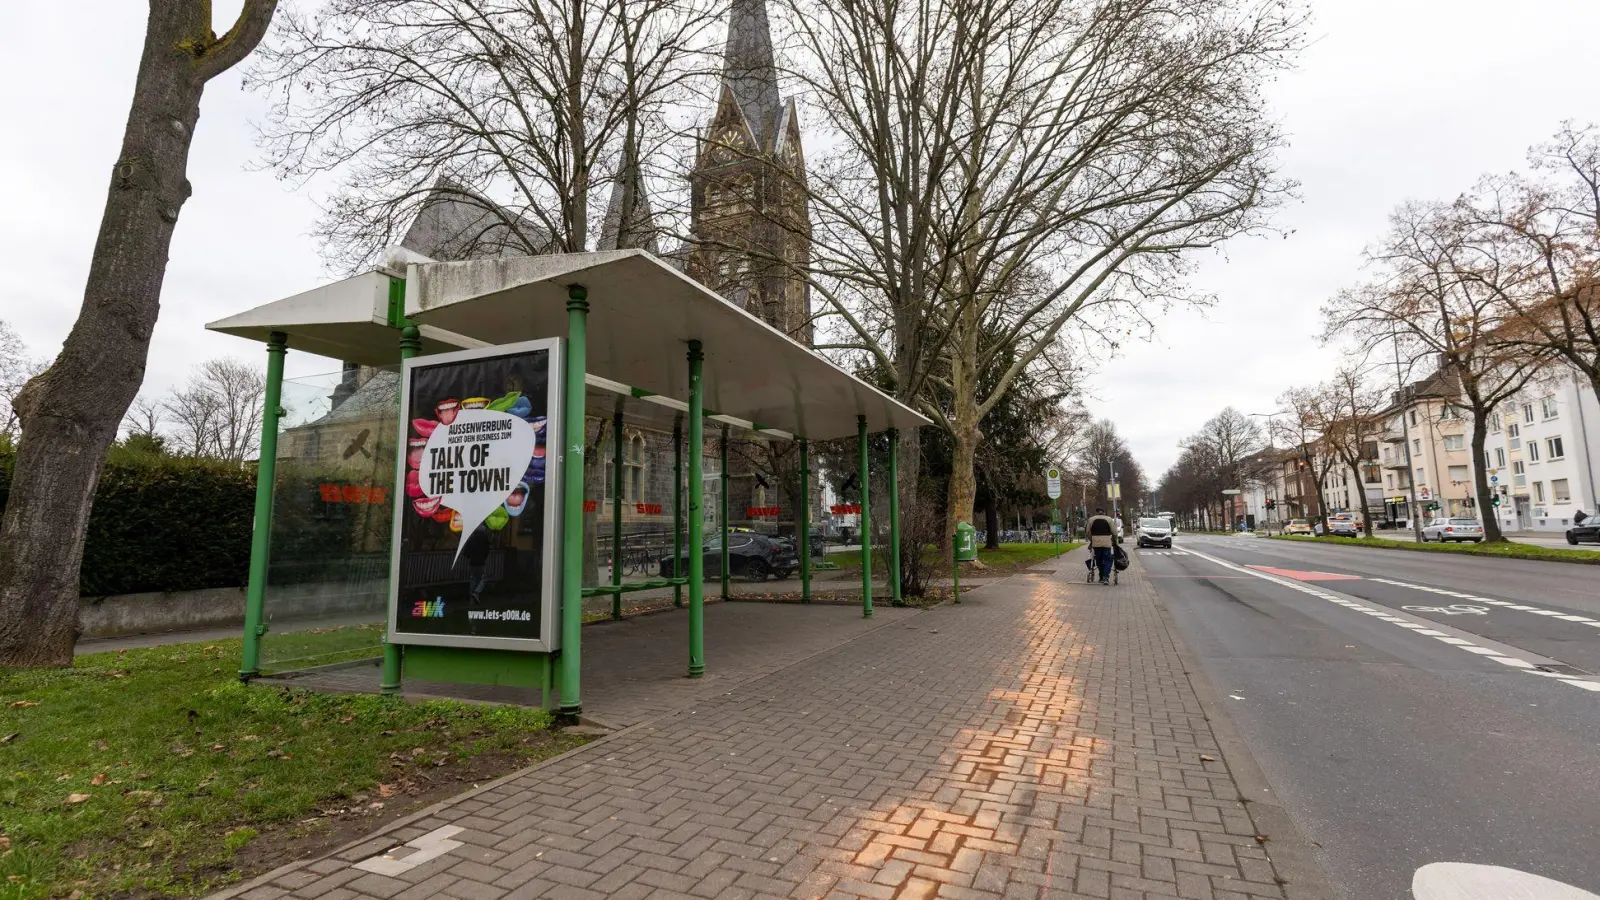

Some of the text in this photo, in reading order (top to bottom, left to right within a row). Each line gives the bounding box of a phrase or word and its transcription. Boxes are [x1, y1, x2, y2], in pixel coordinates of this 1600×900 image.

[448, 431, 512, 444] MACHT DEIN BUSINESS ZUM
[449, 419, 512, 435] AUSSENWERBUNG
[430, 443, 490, 470] TALK OF
[429, 467, 510, 494] THE TOWN!
